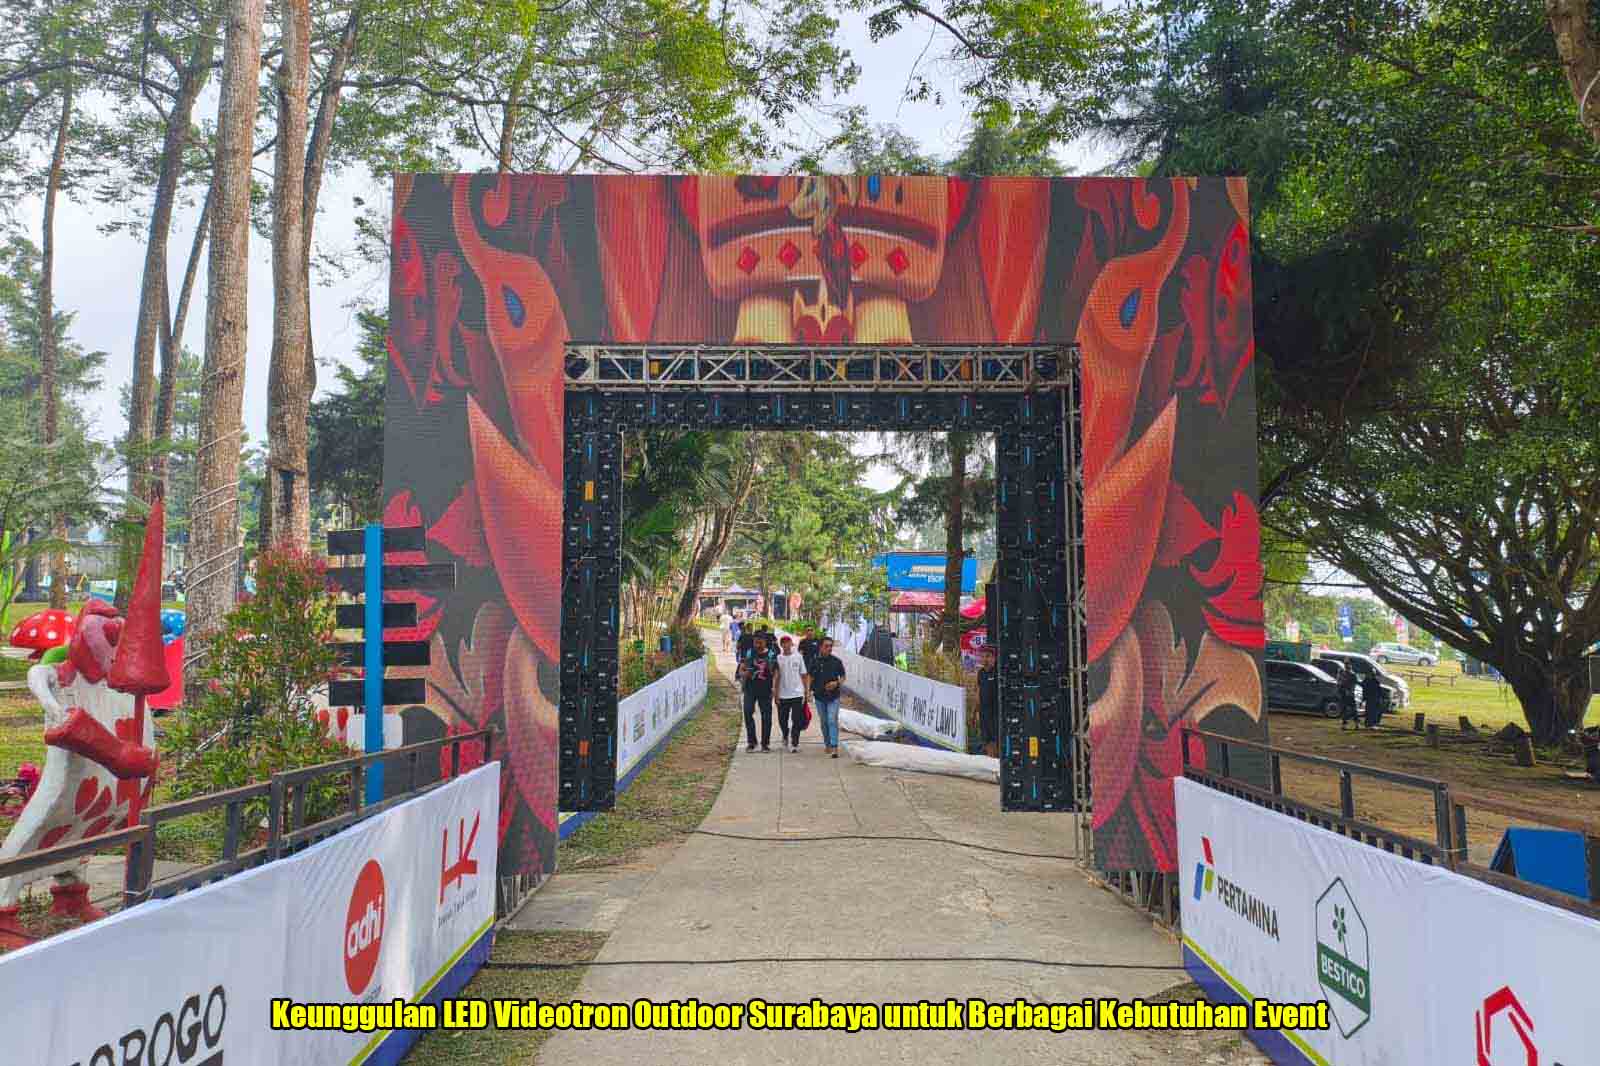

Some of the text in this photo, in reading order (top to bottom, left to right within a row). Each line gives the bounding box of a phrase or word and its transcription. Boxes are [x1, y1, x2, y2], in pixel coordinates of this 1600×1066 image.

[935, 704, 958, 739] LAWU
[347, 892, 383, 959] adhi
[1217, 876, 1280, 942] PERTAMINA
[1320, 953, 1366, 999] BESTICO
